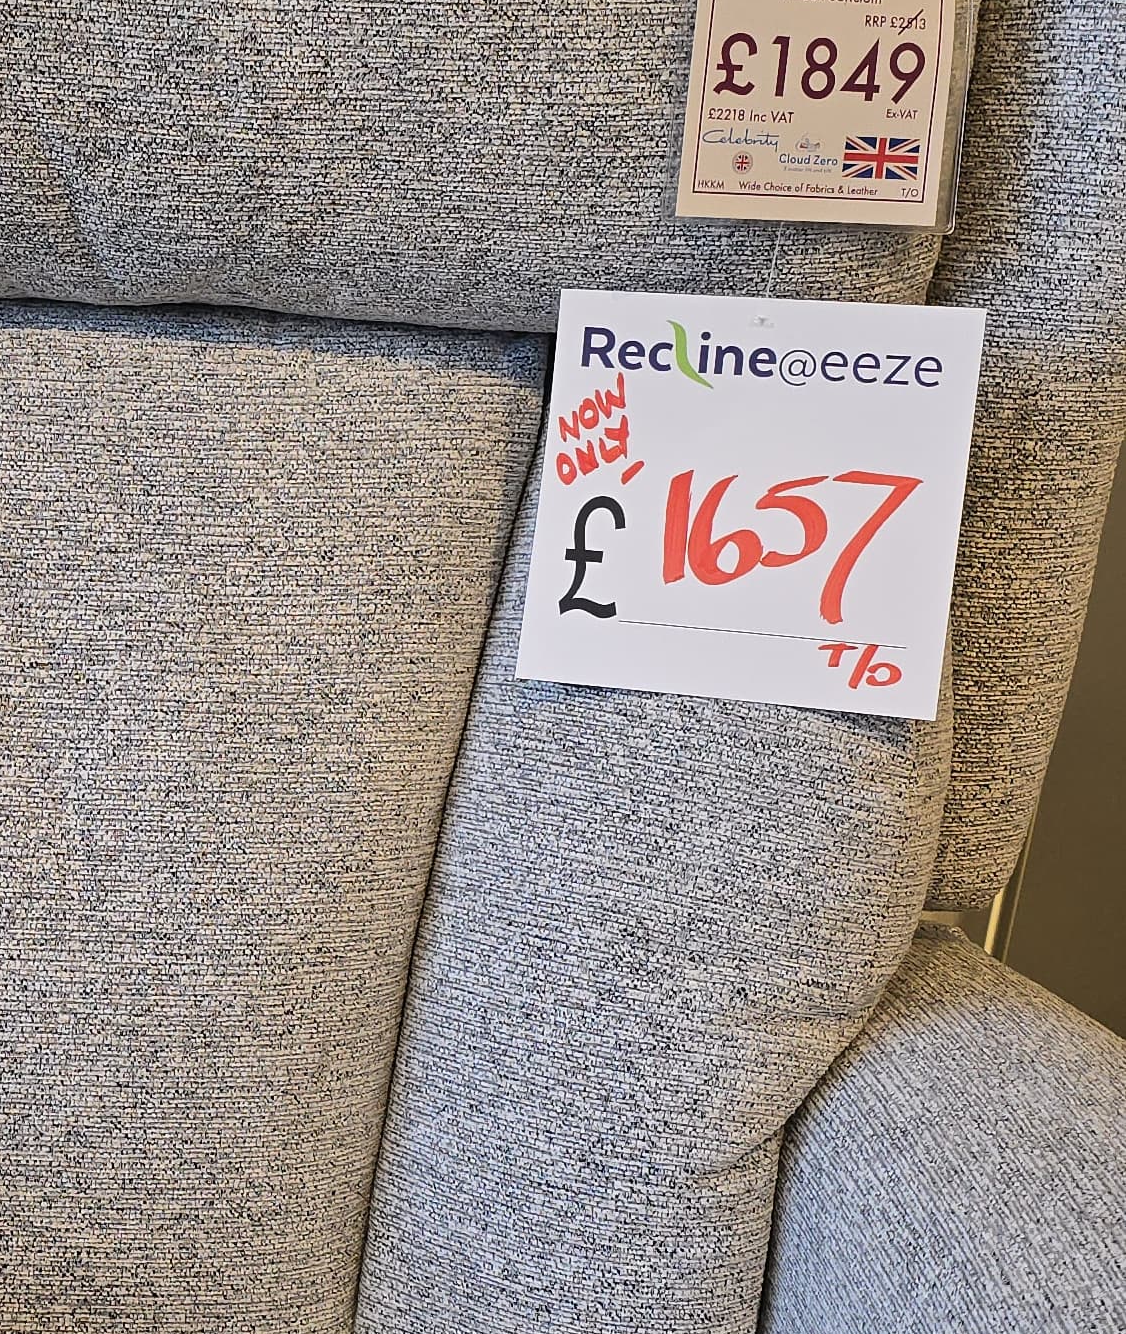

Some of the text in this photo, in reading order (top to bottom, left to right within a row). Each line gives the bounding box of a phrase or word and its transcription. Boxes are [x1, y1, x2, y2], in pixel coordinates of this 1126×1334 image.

[865, 14, 887, 28] RRP
[712, 32, 926, 105] £1849
[708, 108, 795, 125] £2218 Inc VAT
[702, 127, 780, 153] Celebrity
[779, 153, 839, 167] Cloud Zero
[697, 179, 725, 190] HKKM
[738, 181, 879, 197] Wide Choice of Fabrics & Leather
[580, 320, 944, 389] Recline@eeze
[558, 372, 627, 443] NOW
[558, 495, 626, 619] £
[662, 469, 924, 625] 1657
